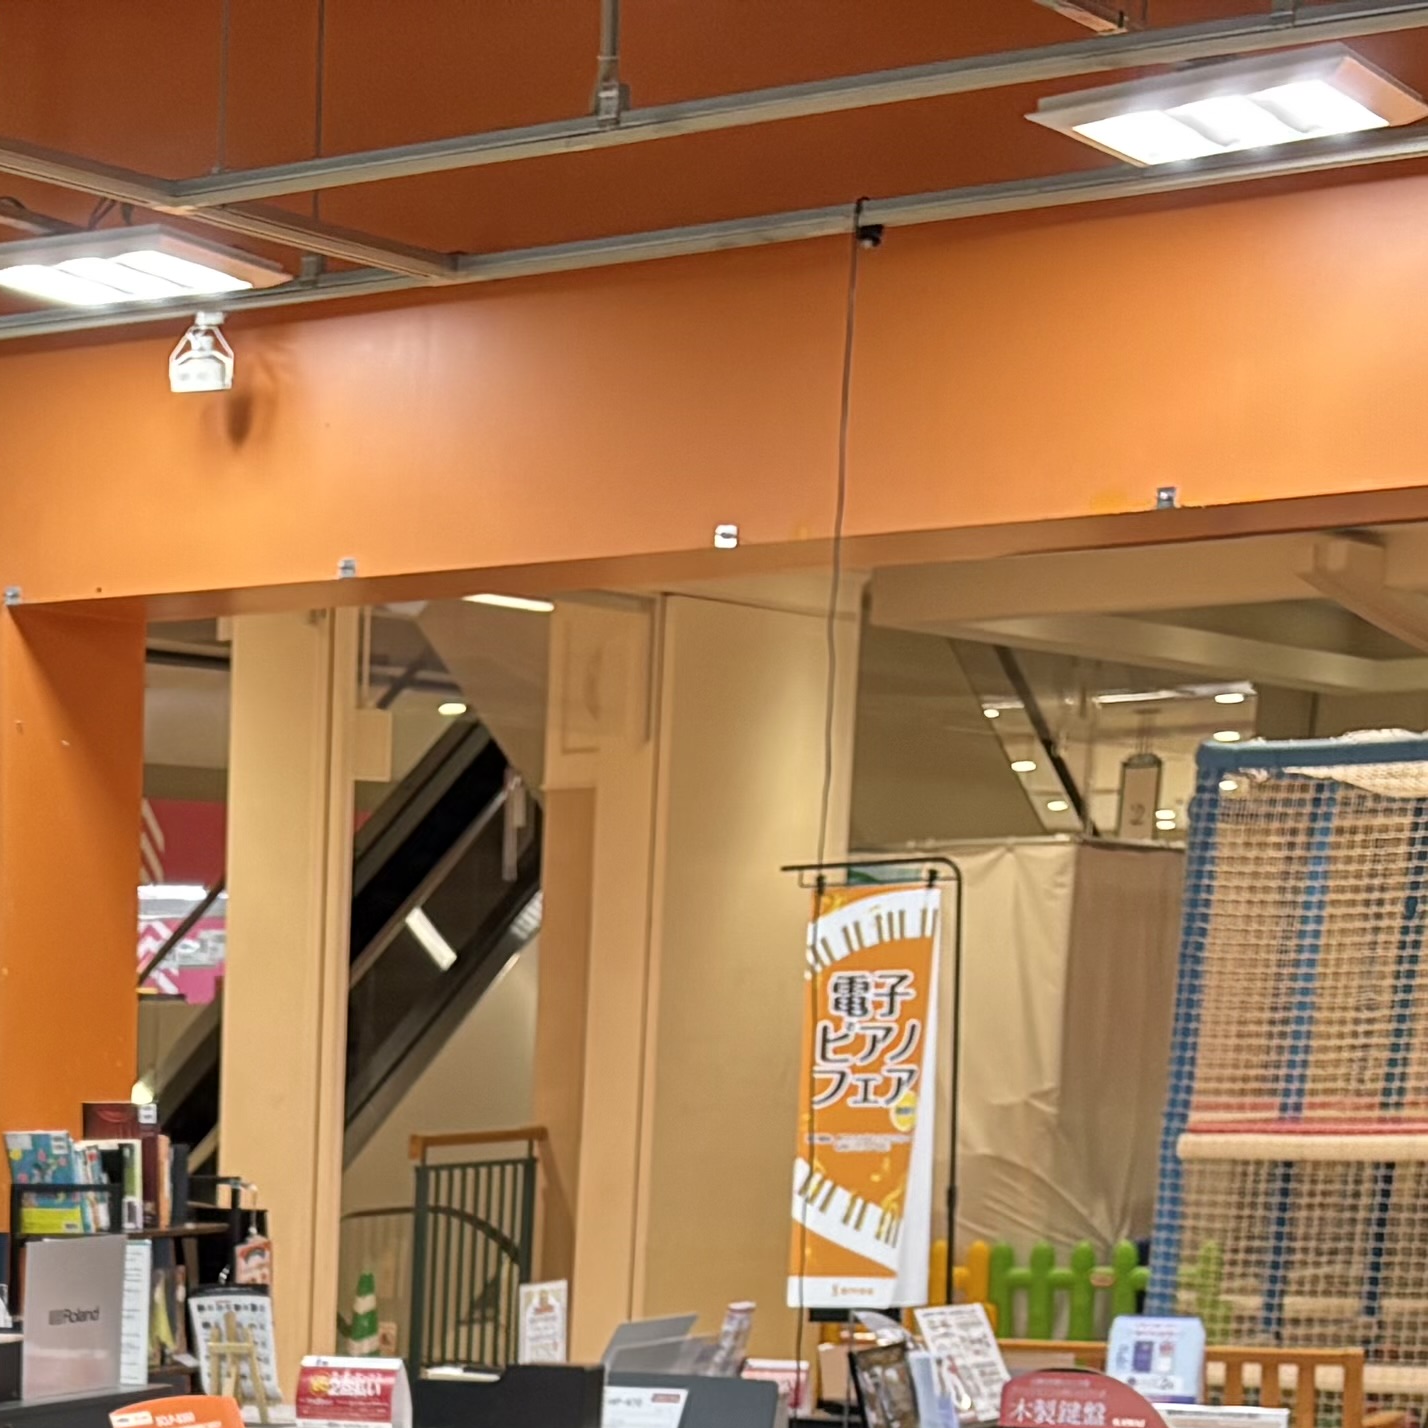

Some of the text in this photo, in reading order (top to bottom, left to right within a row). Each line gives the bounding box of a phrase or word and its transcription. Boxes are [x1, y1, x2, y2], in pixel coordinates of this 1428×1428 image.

[833, 974, 915, 1017] 電子
[820, 1021, 919, 1064] ピアノ
[813, 1068, 917, 1106] フェア
[62, 1304, 101, 1325] Roland
[1009, 1397, 1108, 1427] 木製鍵盤
